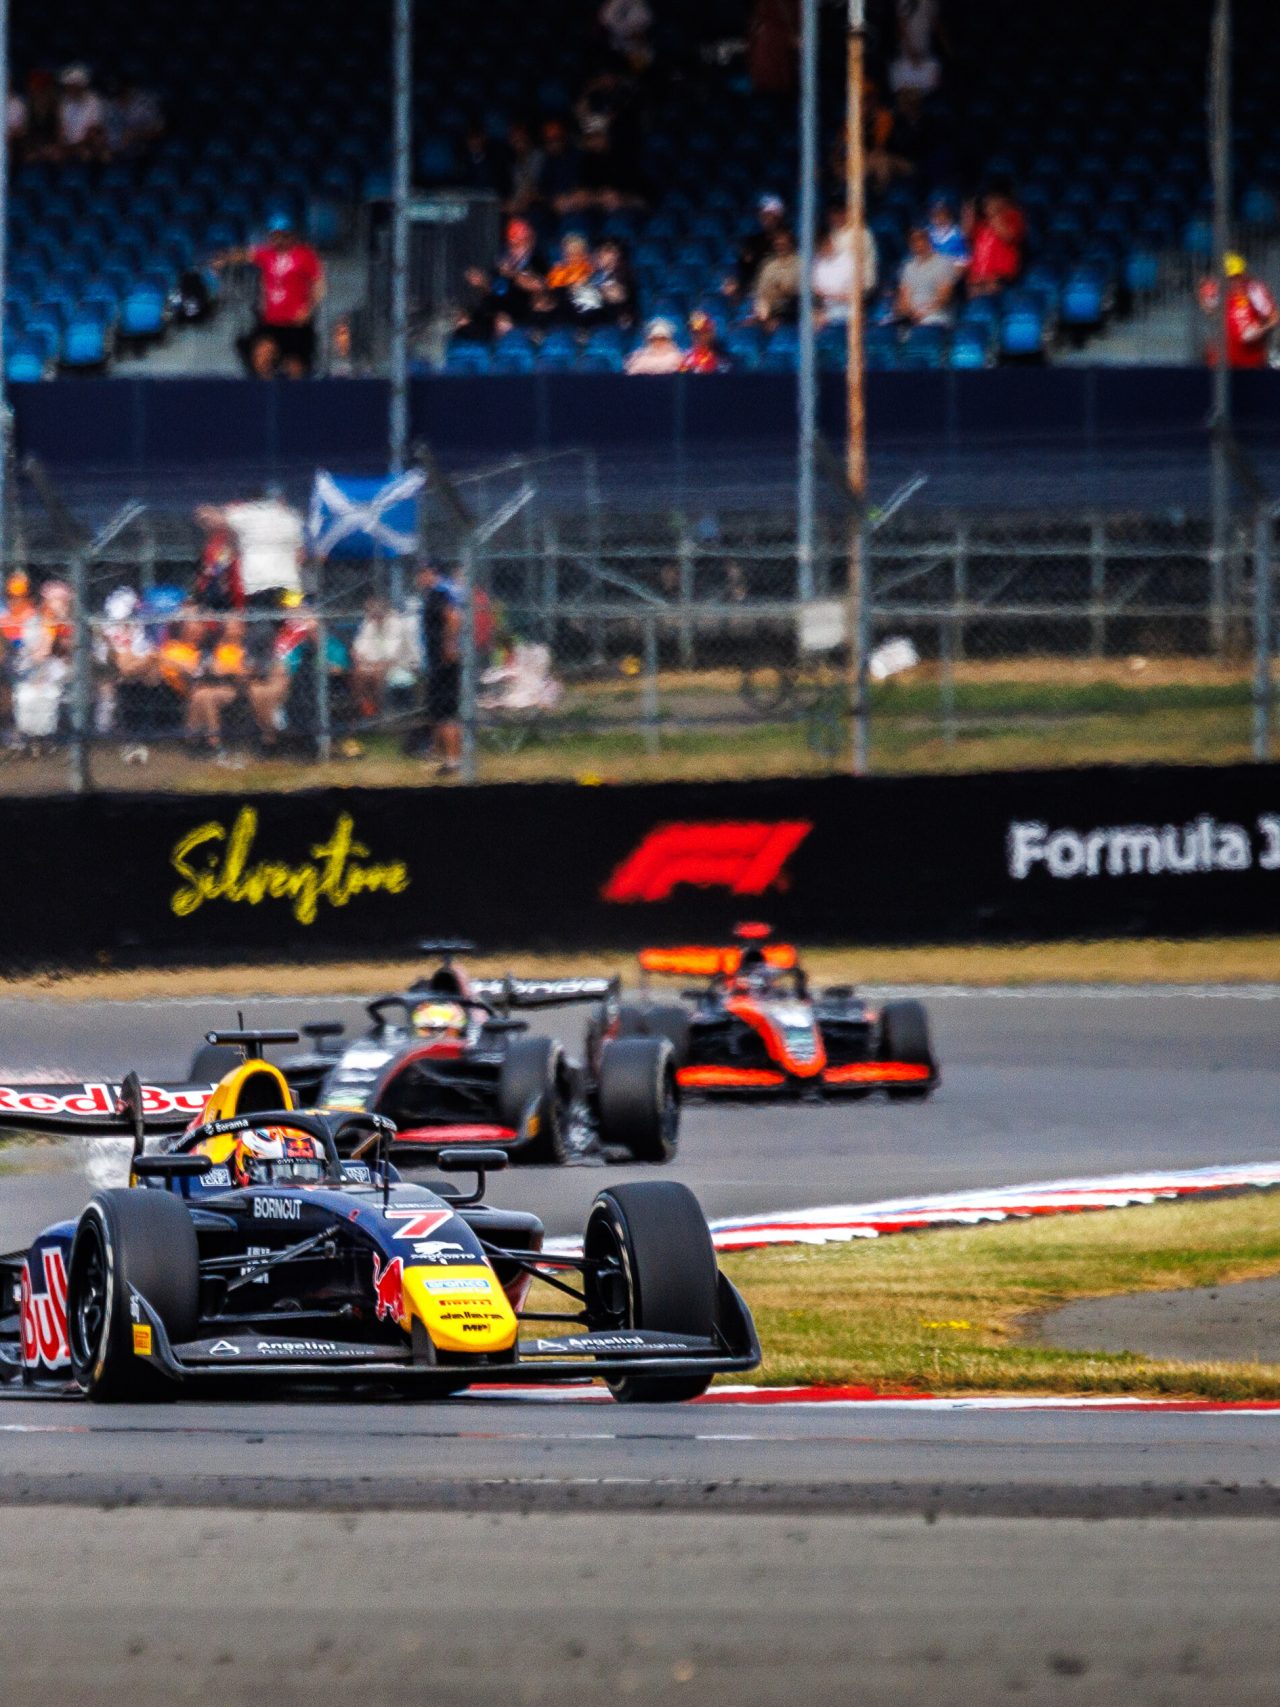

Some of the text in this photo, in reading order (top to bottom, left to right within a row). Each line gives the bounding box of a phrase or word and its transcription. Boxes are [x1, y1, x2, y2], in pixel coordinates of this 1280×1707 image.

[1008, 815, 1251, 879] Formula
[171, 806, 411, 925] Silverstone
[115, 1084, 217, 1115] Bu
[254, 1197, 302, 1220] BORNCUT
[385, 1209, 454, 1239] 7
[440, 1312, 504, 1320] dallara
[257, 1342, 336, 1351] Angelini
[568, 1336, 645, 1347] Angelini
